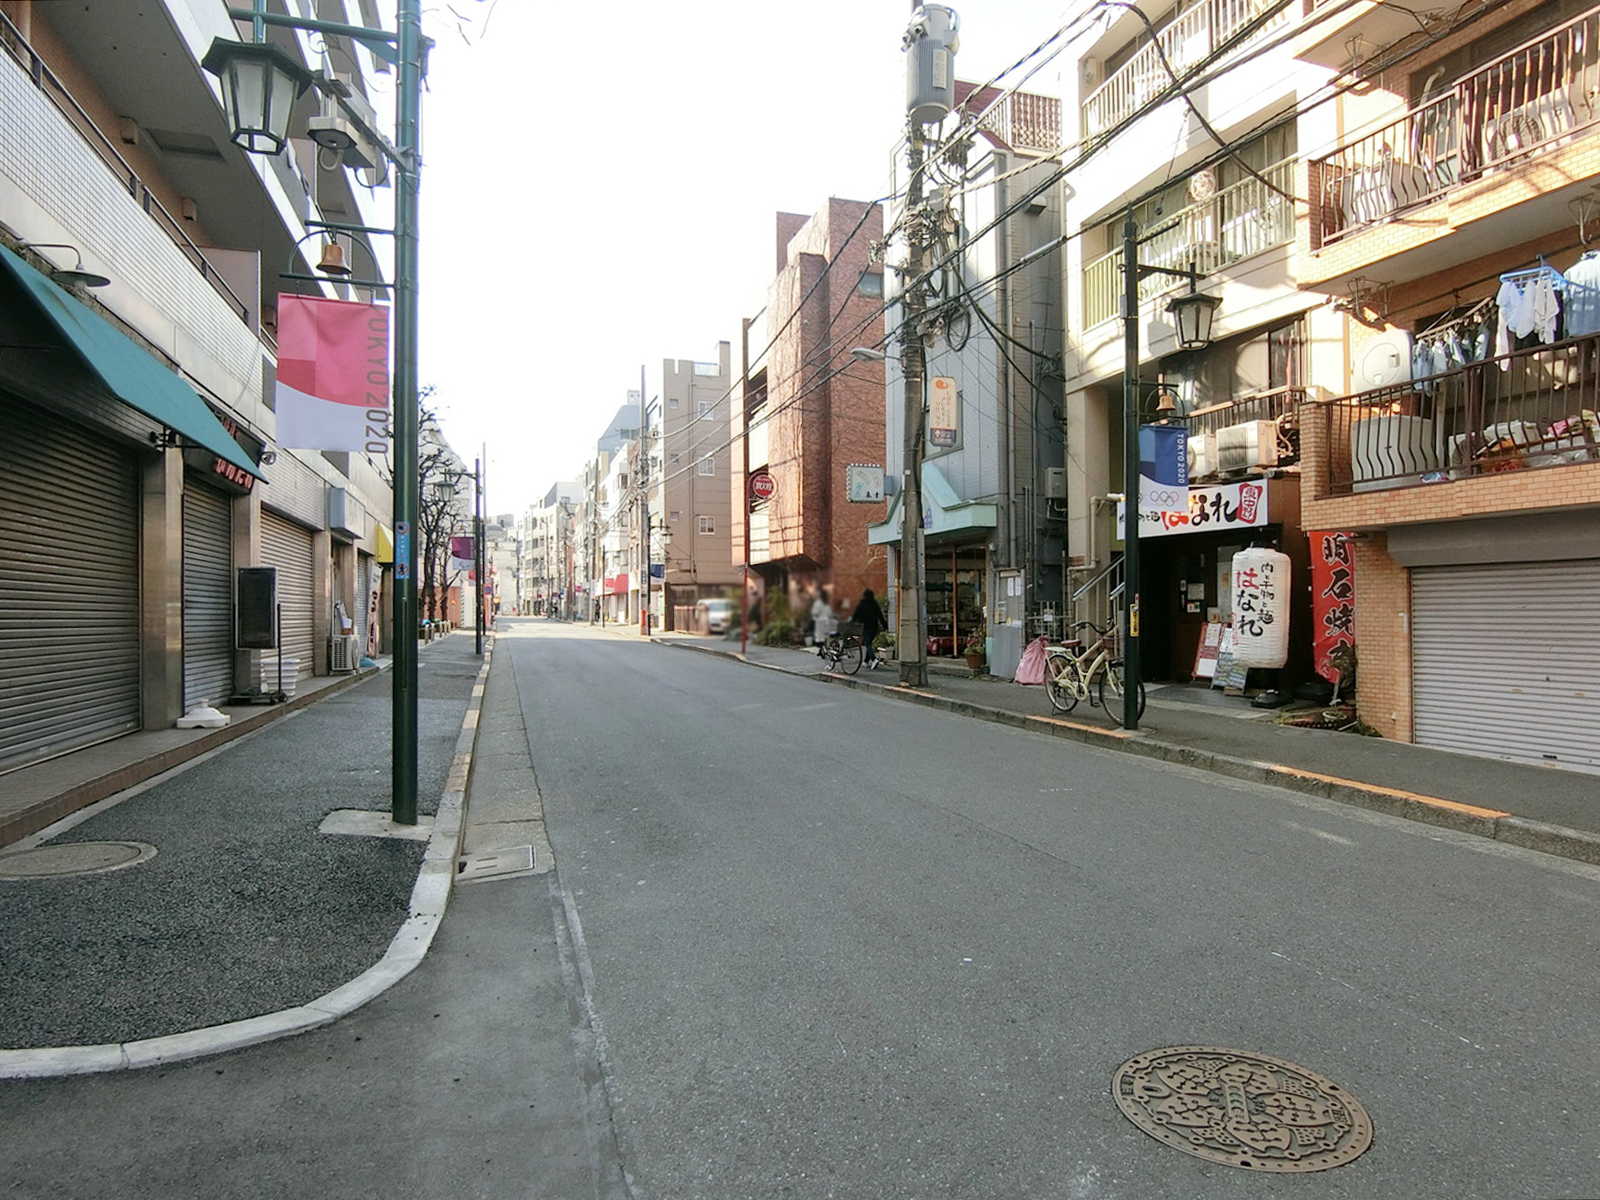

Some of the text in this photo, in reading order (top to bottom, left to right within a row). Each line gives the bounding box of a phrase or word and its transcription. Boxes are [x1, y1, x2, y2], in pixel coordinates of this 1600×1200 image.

[367, 309, 388, 385] OKYO
[1178, 462, 1186, 484] 2020
[1237, 567, 1263, 637] はなれ
